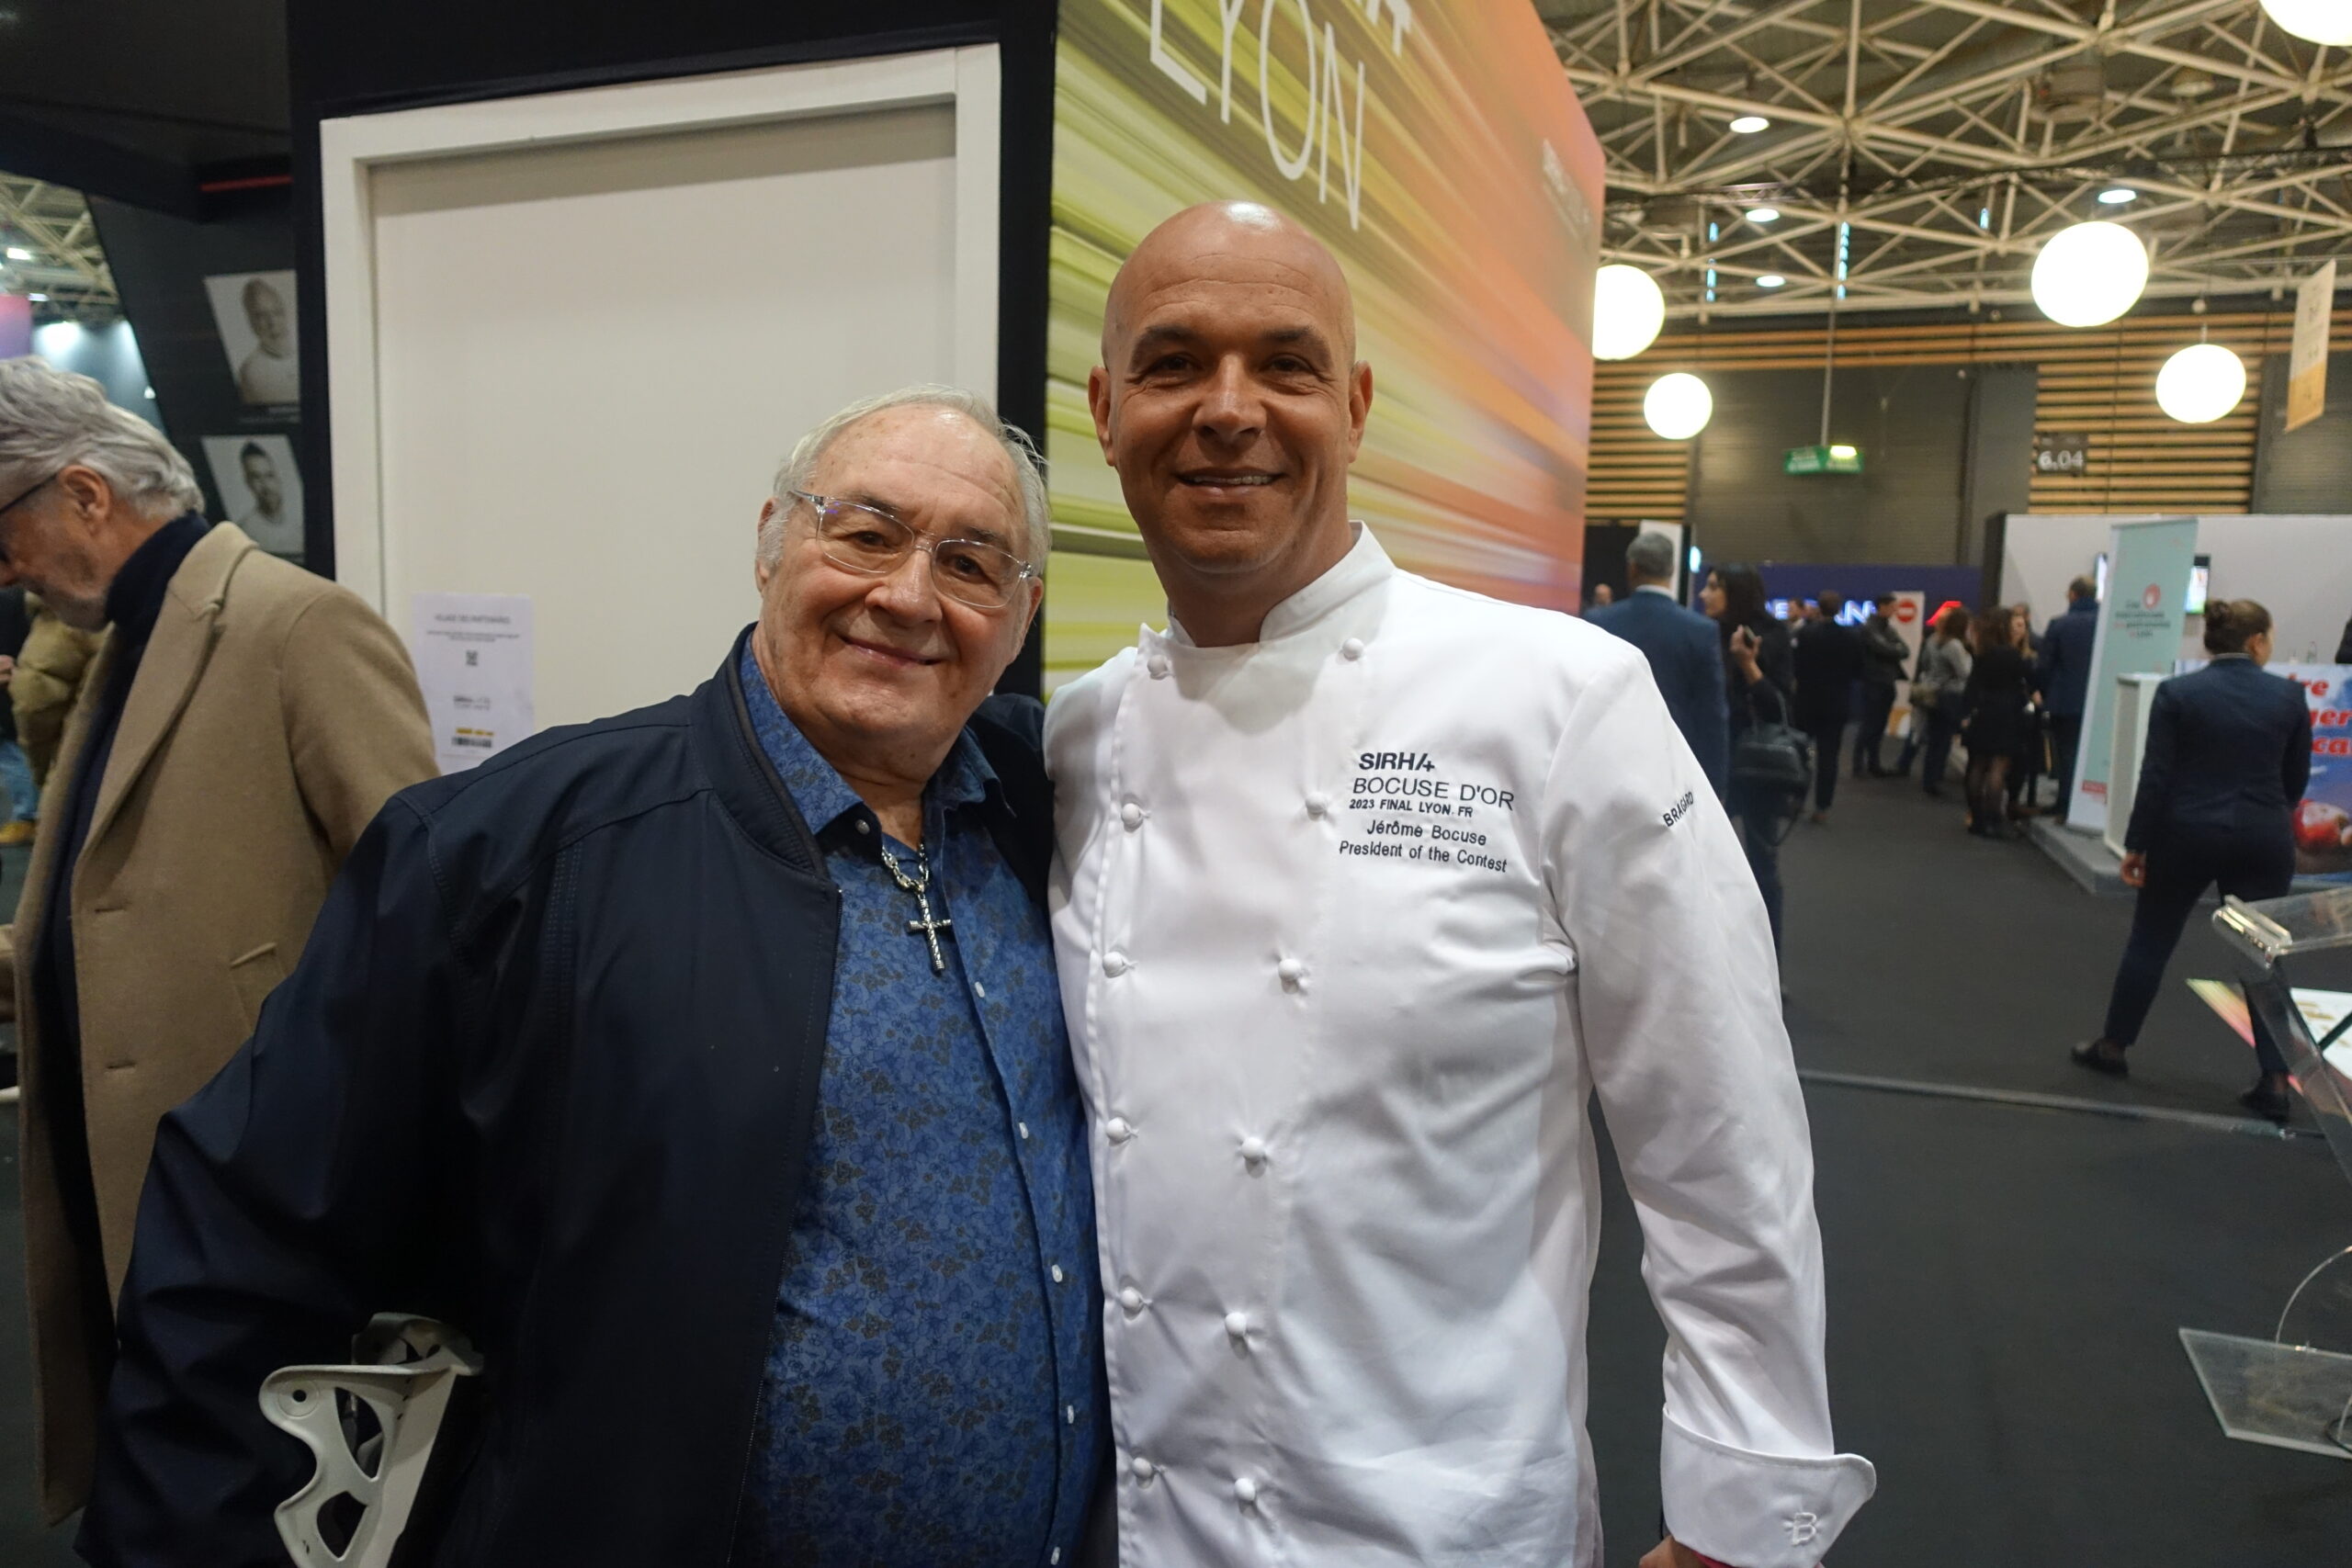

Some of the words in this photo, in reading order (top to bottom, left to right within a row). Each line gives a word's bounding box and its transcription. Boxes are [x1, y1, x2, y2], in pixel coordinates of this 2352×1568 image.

[1150, 0, 1365, 231] LYON
[2038, 449, 2084, 471] 6.04
[1349, 798, 1375, 809] 2023
[1379, 798, 1413, 812] FINAL
[1457, 806, 1474, 818] FR
[1352, 776, 1450, 799] BOCUSE
[1459, 784, 1515, 811] D'OR
[1366, 819, 1423, 838] Jérôme
[1430, 825, 1487, 846] Bocuse
[1339, 840, 1403, 857] President
[1408, 845, 1423, 860] of
[1429, 846, 1450, 863] the
[1456, 850, 1508, 873] Contest
